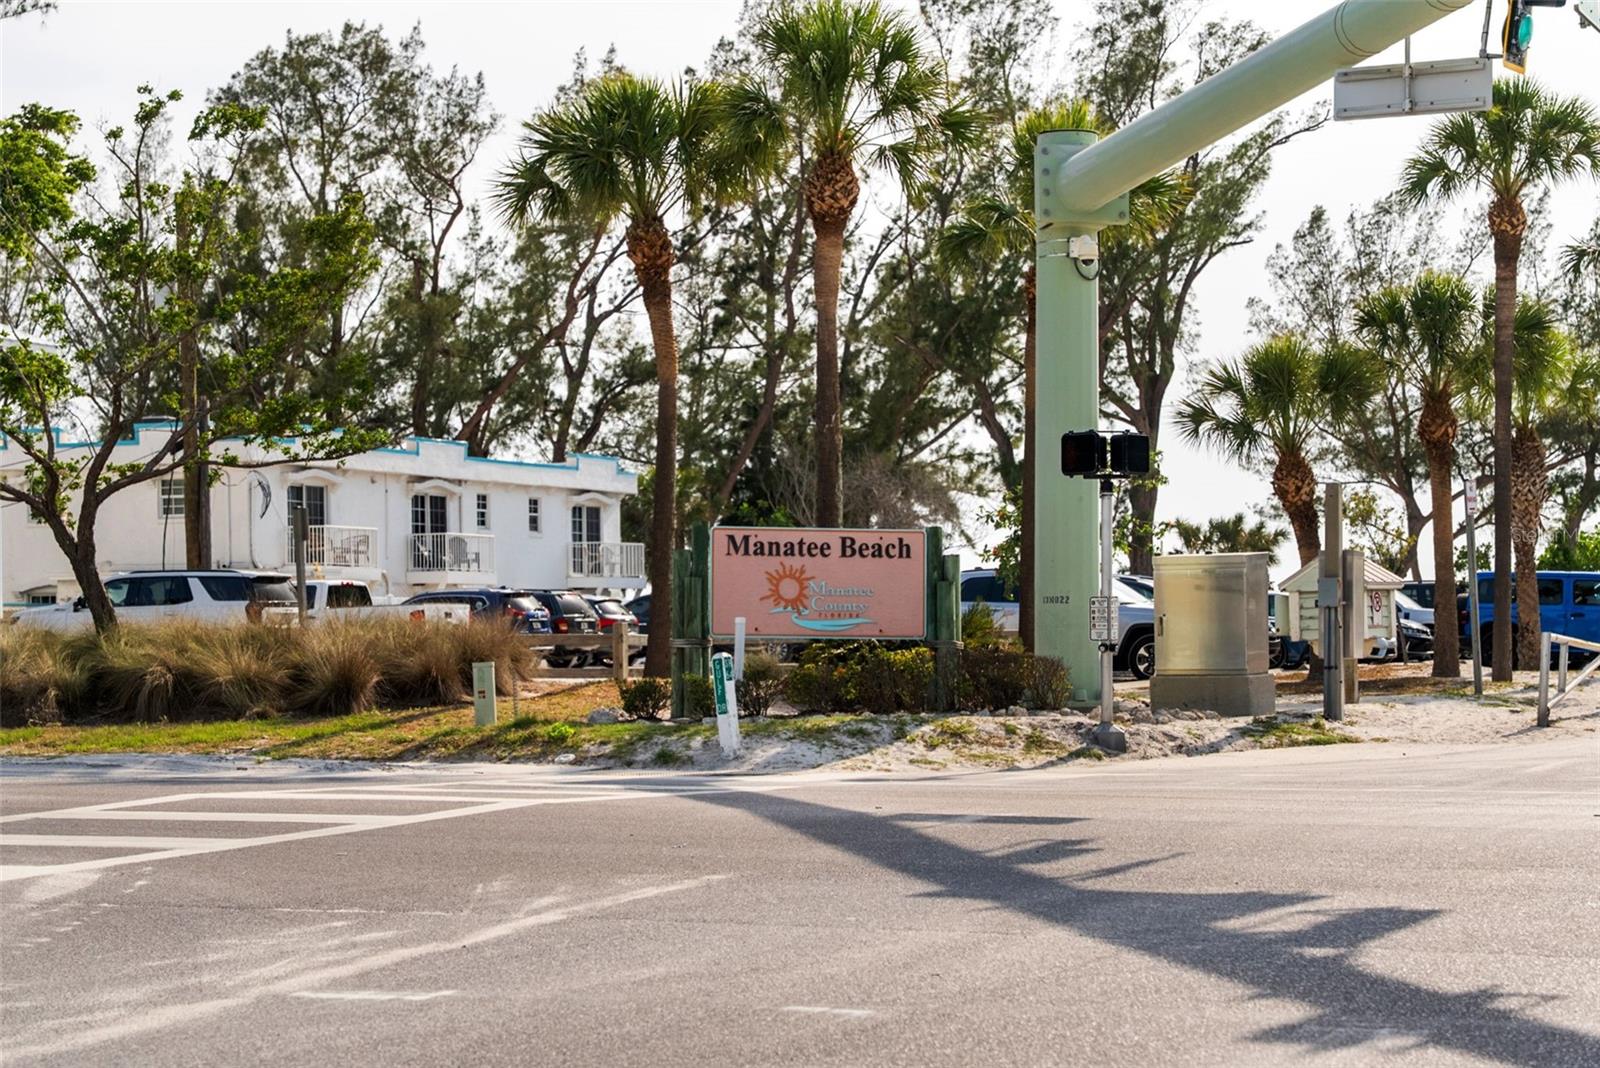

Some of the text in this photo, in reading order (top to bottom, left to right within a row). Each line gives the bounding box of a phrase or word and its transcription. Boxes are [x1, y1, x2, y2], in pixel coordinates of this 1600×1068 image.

[726, 534, 912, 559] Manatee Beach
[807, 580, 874, 597] Manatee
[811, 595, 868, 613] County
